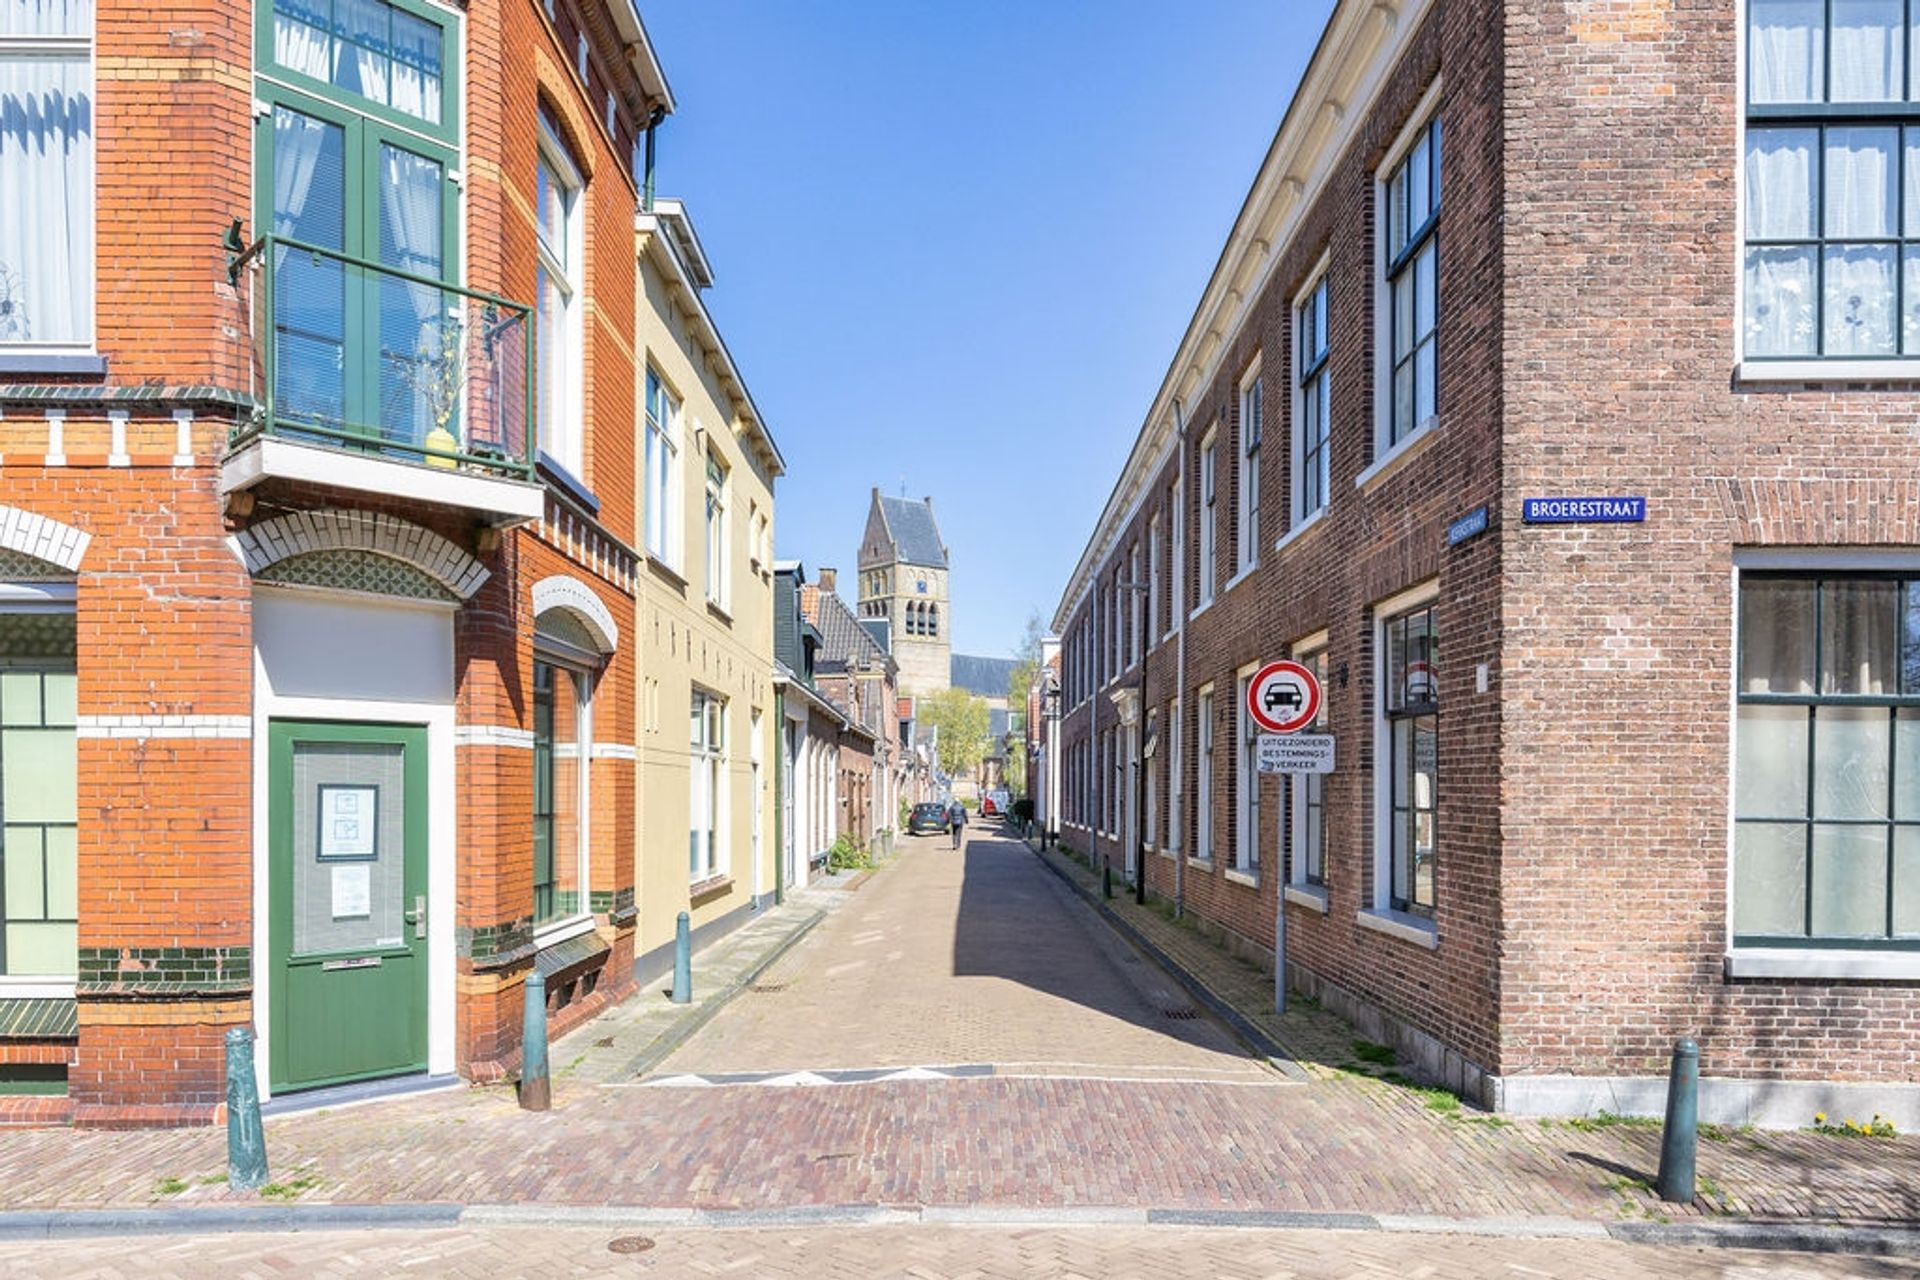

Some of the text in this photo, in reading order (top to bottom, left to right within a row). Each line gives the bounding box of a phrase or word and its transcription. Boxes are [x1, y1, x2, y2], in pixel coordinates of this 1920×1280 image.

[1531, 500, 1640, 517] BROERESTRAAT
[1262, 738, 1331, 747] UITGEZONDERD
[1262, 749, 1330, 758] BESTEMMINGS-
[1276, 760, 1317, 769] VERKEER
